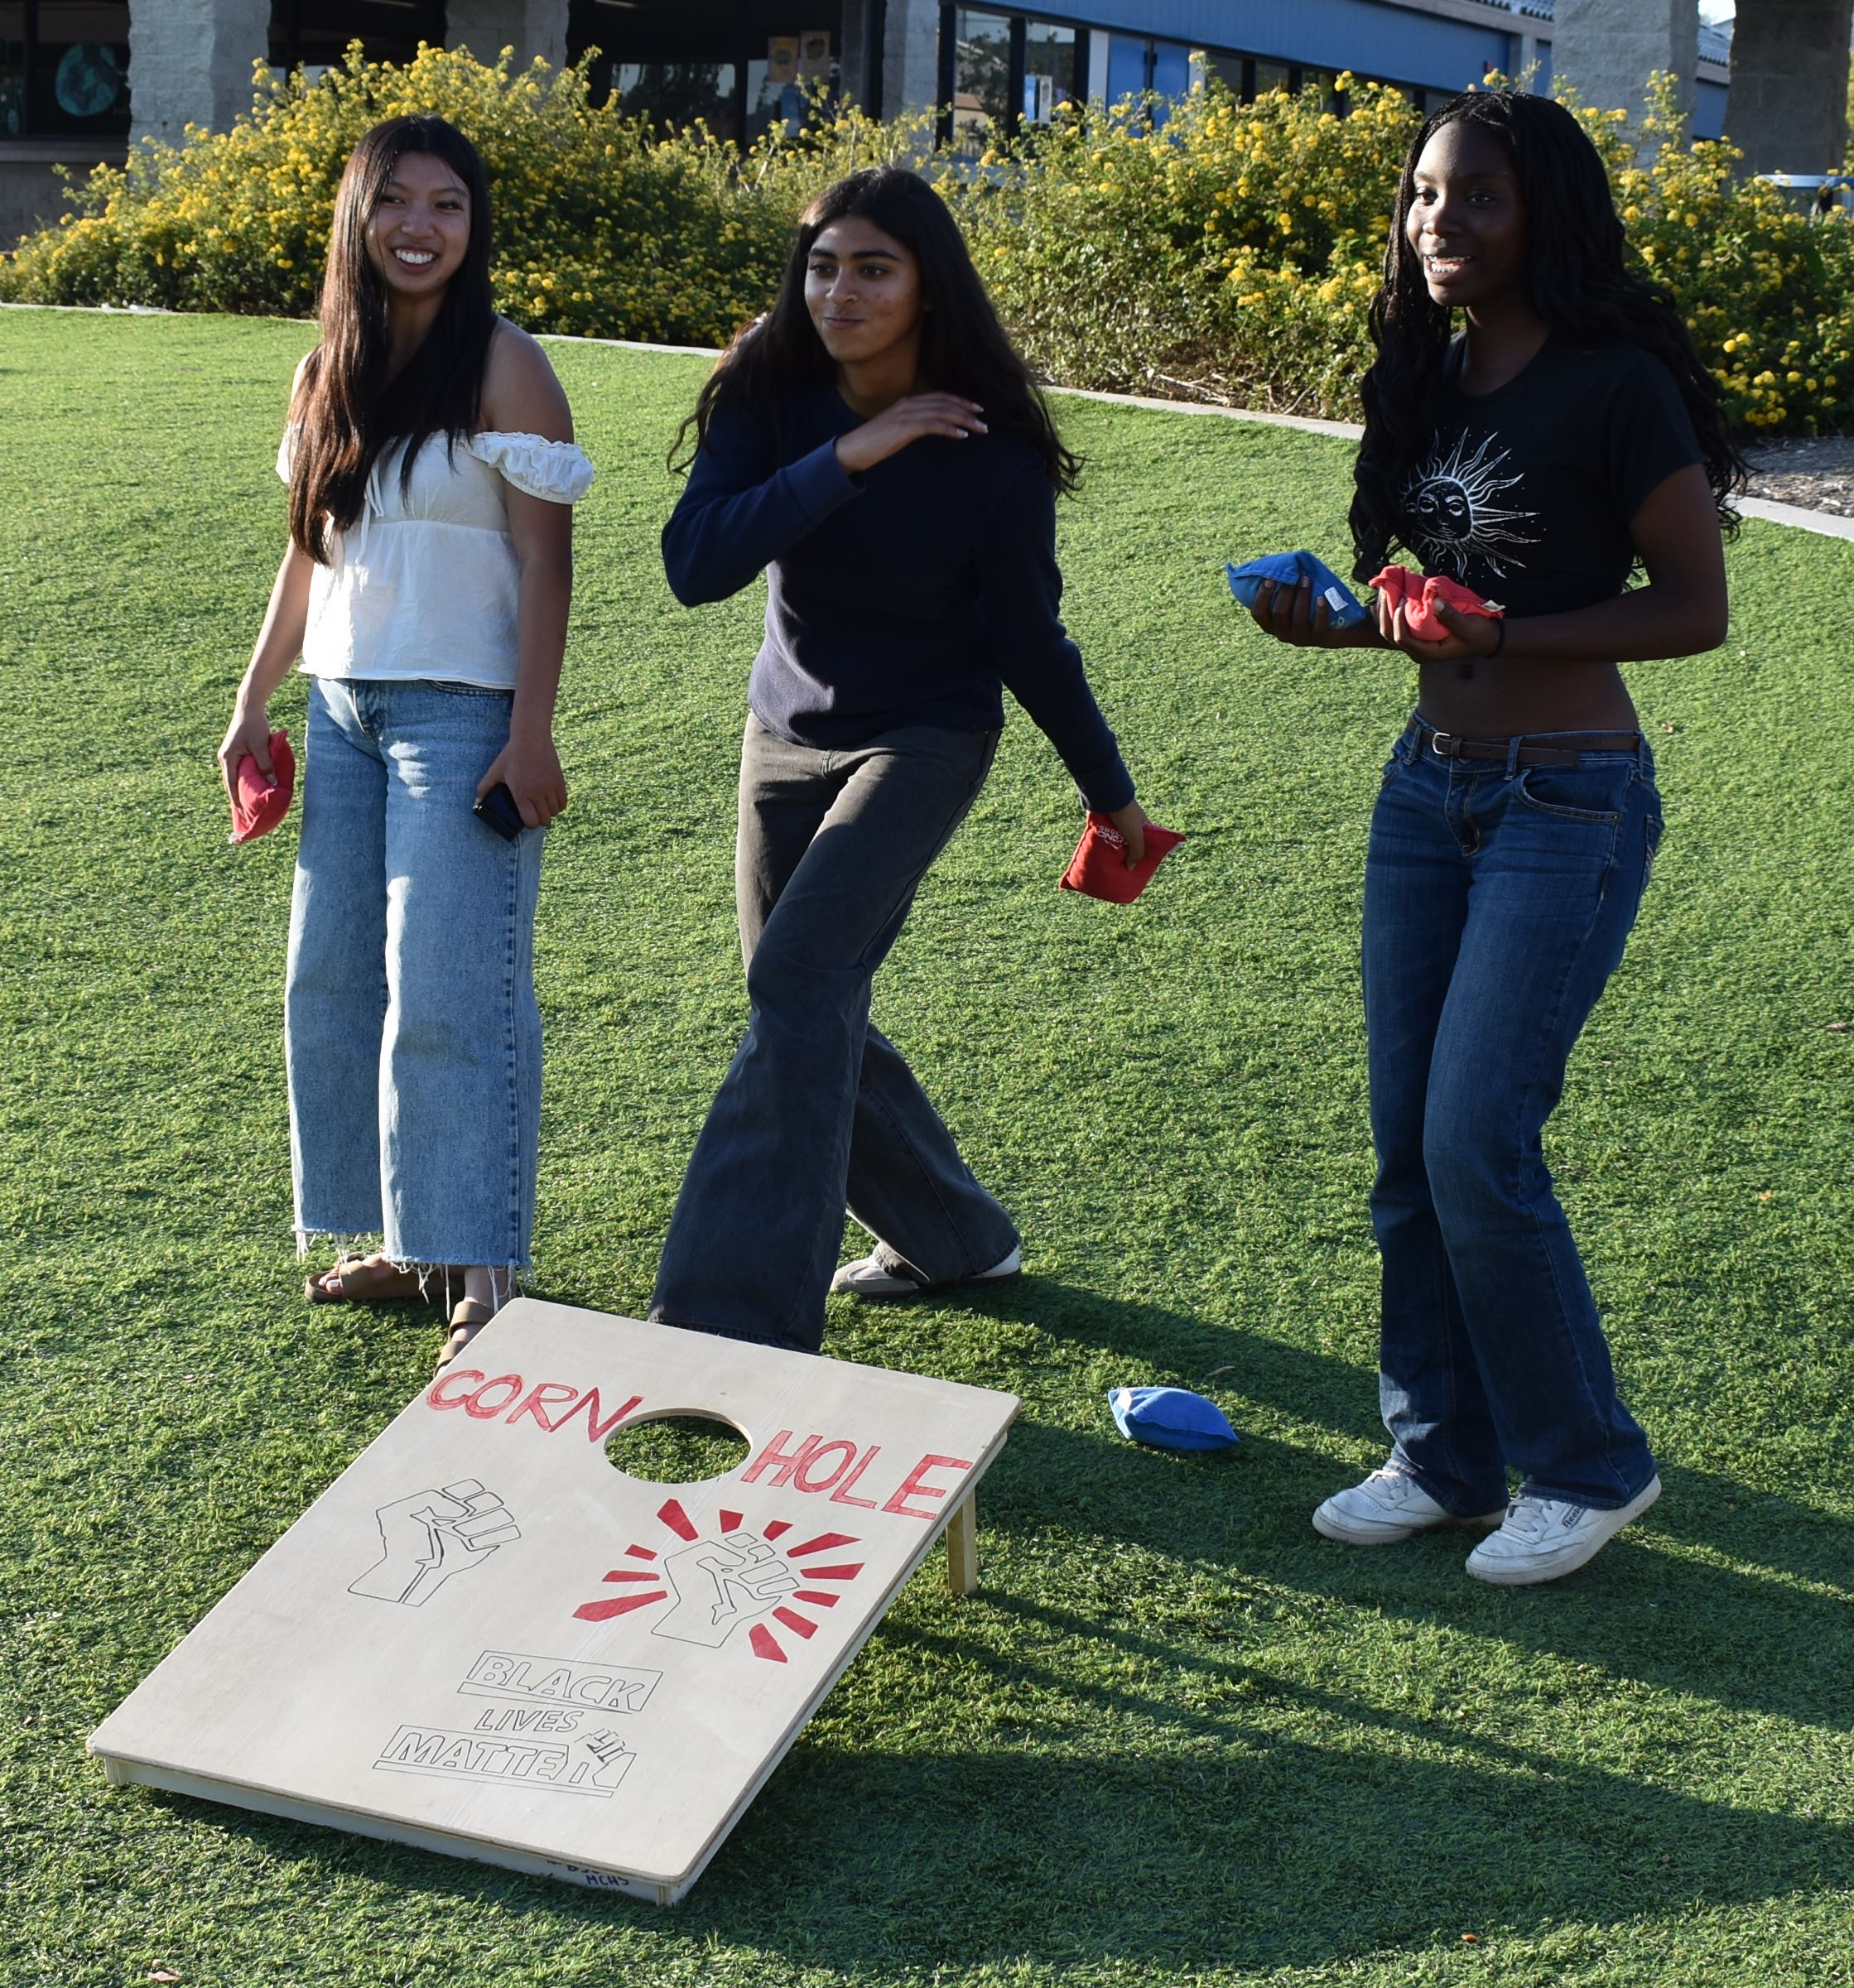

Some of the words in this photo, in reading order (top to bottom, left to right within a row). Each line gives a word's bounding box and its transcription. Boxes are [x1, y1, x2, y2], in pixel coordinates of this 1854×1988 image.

[426, 1369, 644, 1443] CORN
[740, 1430, 973, 1521] HOLE
[1563, 1506, 1581, 1528] Reeb
[470, 1655, 645, 1711] BLACK
[474, 1708, 585, 1732] LIVES
[585, 1874, 630, 1886] MCHS
